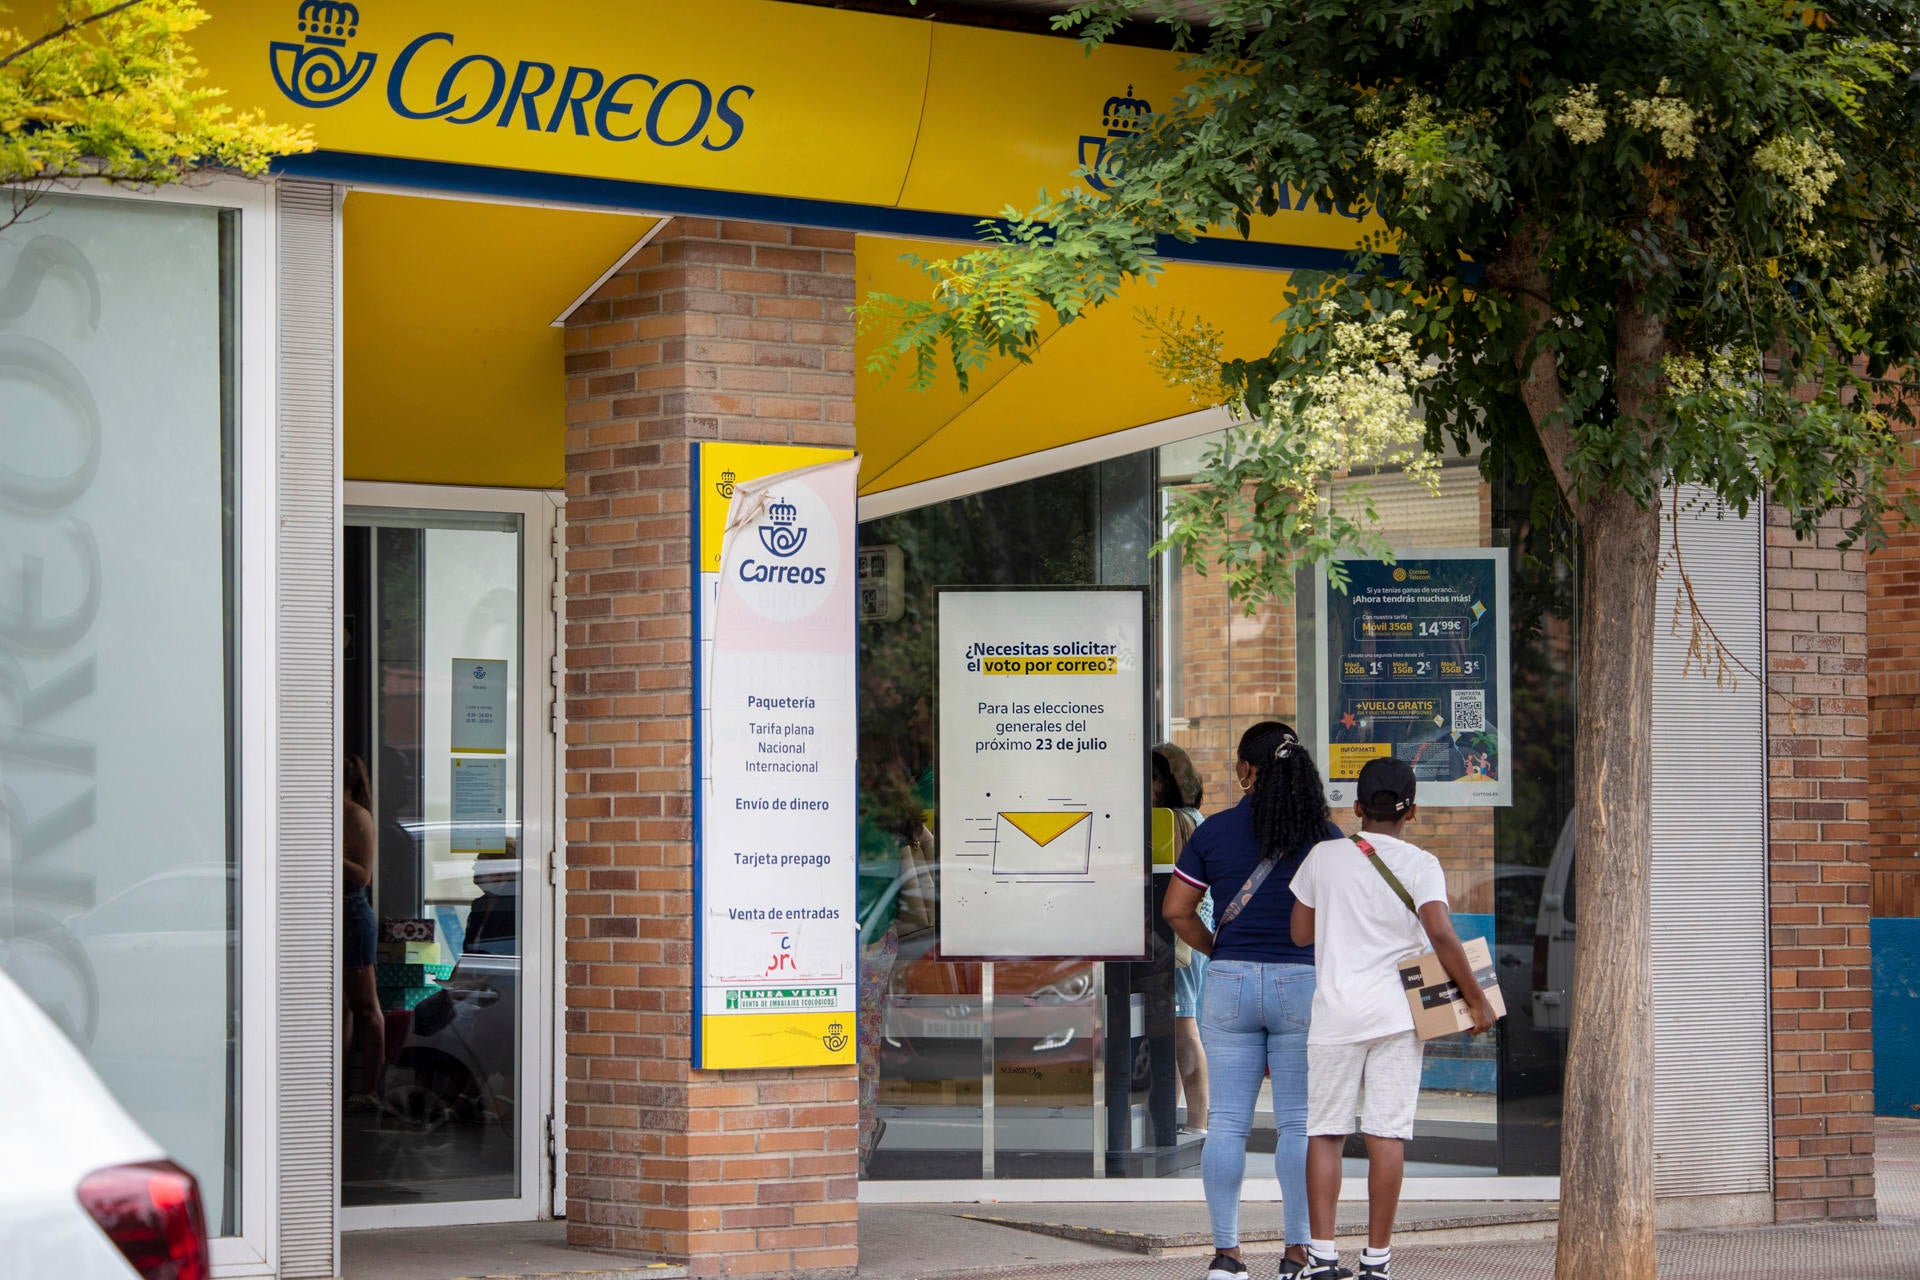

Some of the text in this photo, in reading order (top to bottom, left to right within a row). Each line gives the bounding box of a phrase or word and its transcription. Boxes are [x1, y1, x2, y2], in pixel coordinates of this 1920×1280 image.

[386, 31, 754, 152] CORREOS
[739, 559, 826, 584] Correos
[1373, 588, 1382, 596] ya
[1353, 594, 1471, 605] ¡Ahora tendrás muchas más!
[1362, 621, 1387, 631] Móvil
[1388, 622, 1413, 631] 35GB
[965, 641, 1117, 659] ¿Necesitas solicitar
[967, 658, 1116, 675] el voto por correo?
[748, 695, 816, 711] Paquetería
[978, 701, 1105, 714] Para las elecciones
[749, 722, 815, 738] Tarifa plana
[996, 720, 1086, 735] generales del
[758, 741, 806, 754] Nacional
[975, 738, 1108, 753] próximo 23 de julio
[745, 760, 819, 773] Internacional
[735, 797, 829, 811] Envío de dinero
[734, 852, 831, 868] Tarjeta prepago
[729, 907, 840, 920] Venta de entradas
[791, 988, 835, 997] VERDE
[742, 1000, 759, 1008] VENTA
[769, 999, 800, 1007] EMBALAJES
